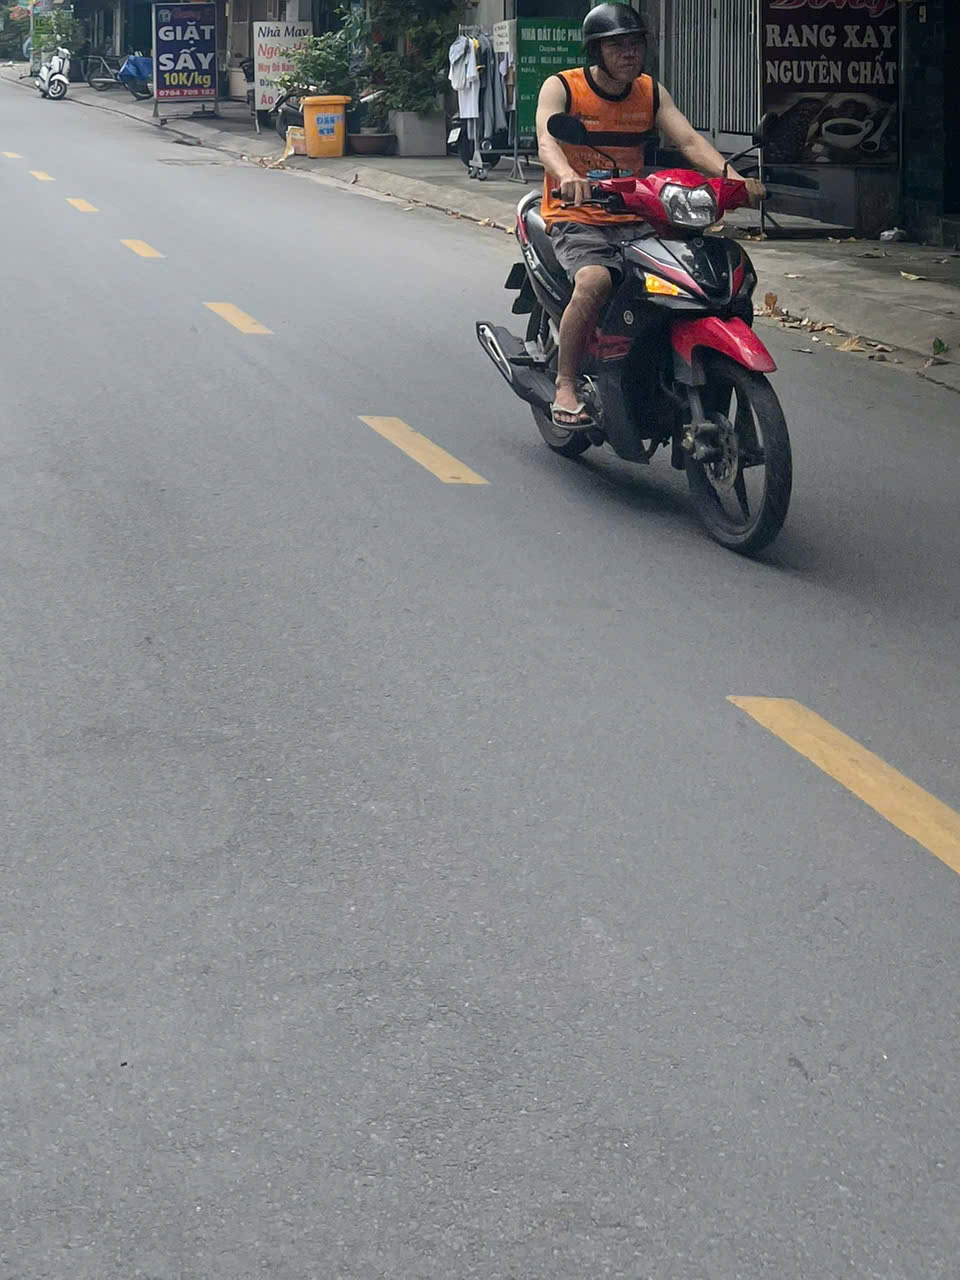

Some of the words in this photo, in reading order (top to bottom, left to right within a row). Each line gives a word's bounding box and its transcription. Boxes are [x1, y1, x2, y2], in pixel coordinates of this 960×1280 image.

[158, 21, 215, 44] GIẶT
[258, 25, 280, 38] Nhà
[765, 24, 837, 48] RANG
[843, 24, 897, 49] XAY
[158, 47, 215, 71] SẤY
[765, 54, 841, 84] NGUYÊN
[847, 51, 897, 84] CHẤT
[163, 72, 211, 87] 10K/kg
